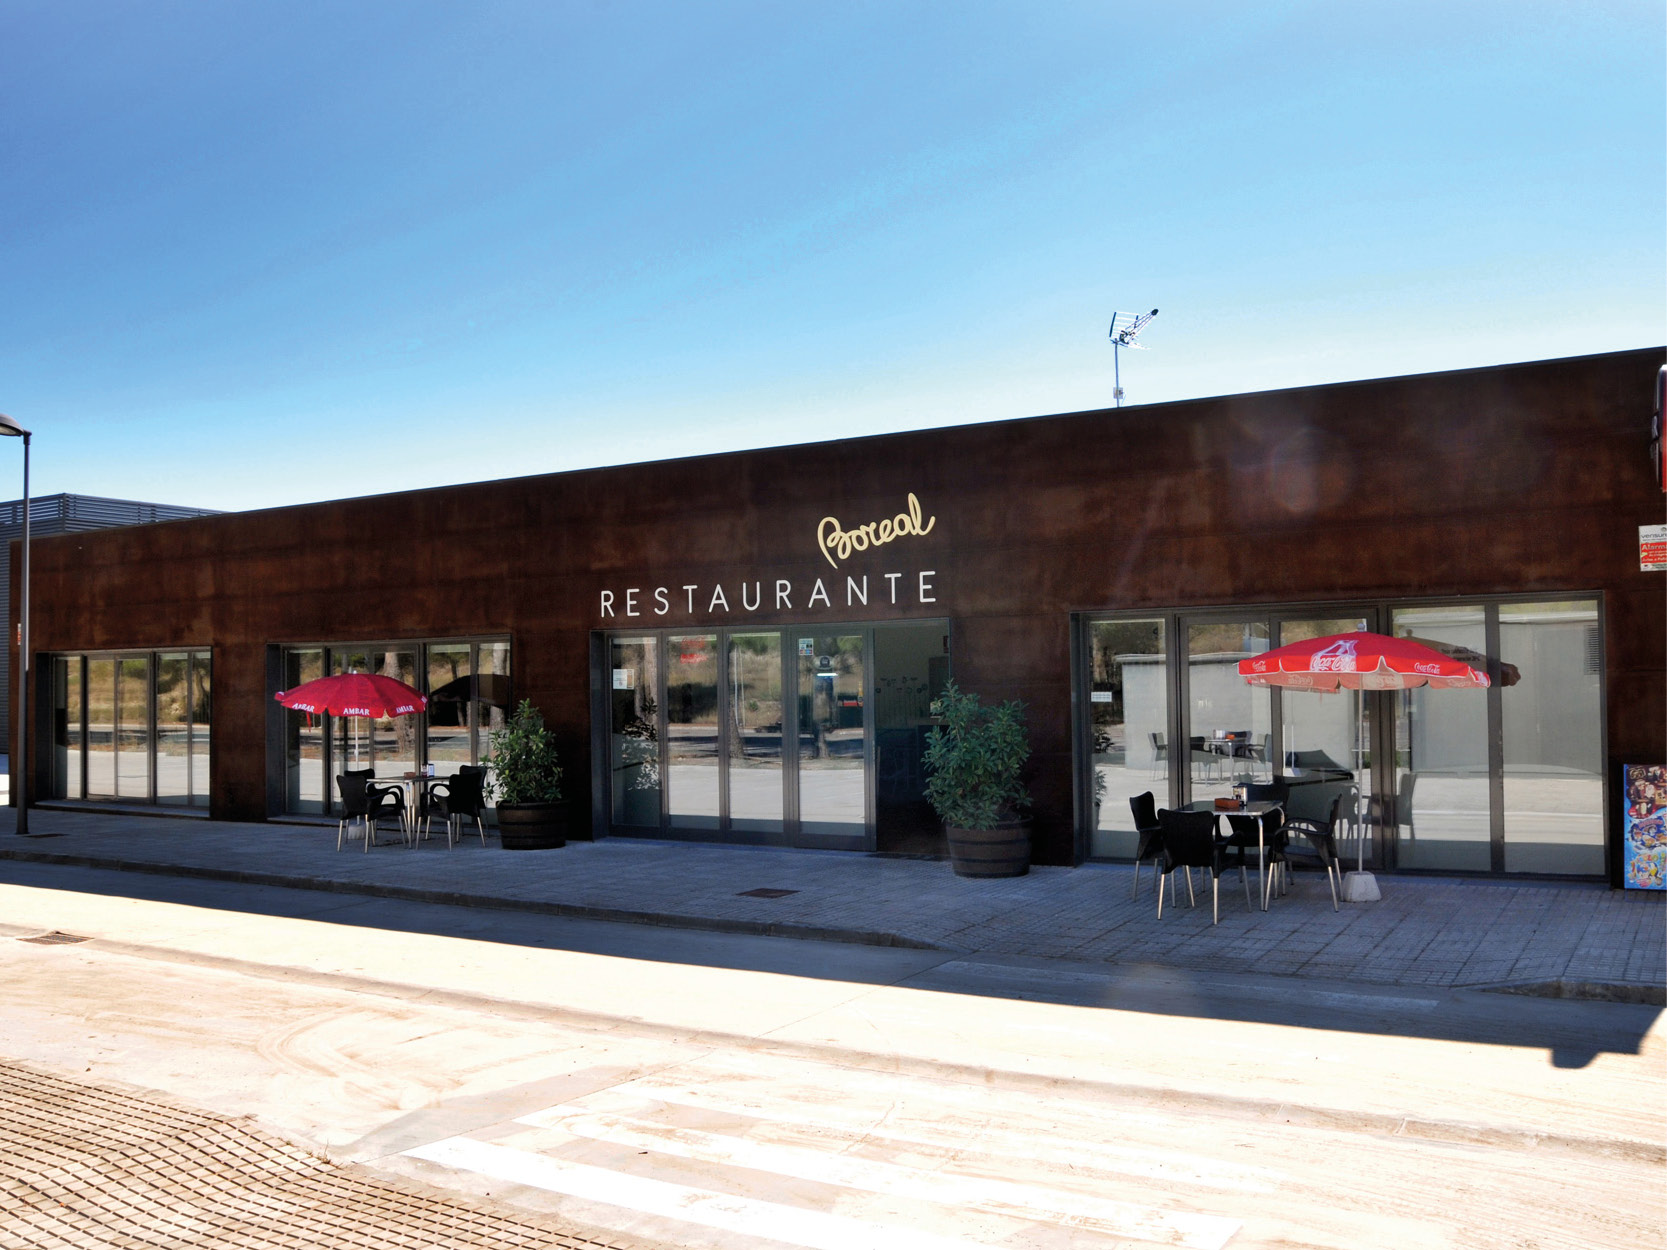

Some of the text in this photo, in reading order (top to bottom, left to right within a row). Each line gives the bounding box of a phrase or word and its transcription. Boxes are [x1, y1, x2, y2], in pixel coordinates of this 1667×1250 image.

[817, 492, 935, 569] Boreal
[1641, 543, 1667, 551] Alarm
[600, 571, 936, 617] RESTAURANTE
[343, 707, 370, 716] AMBAR
